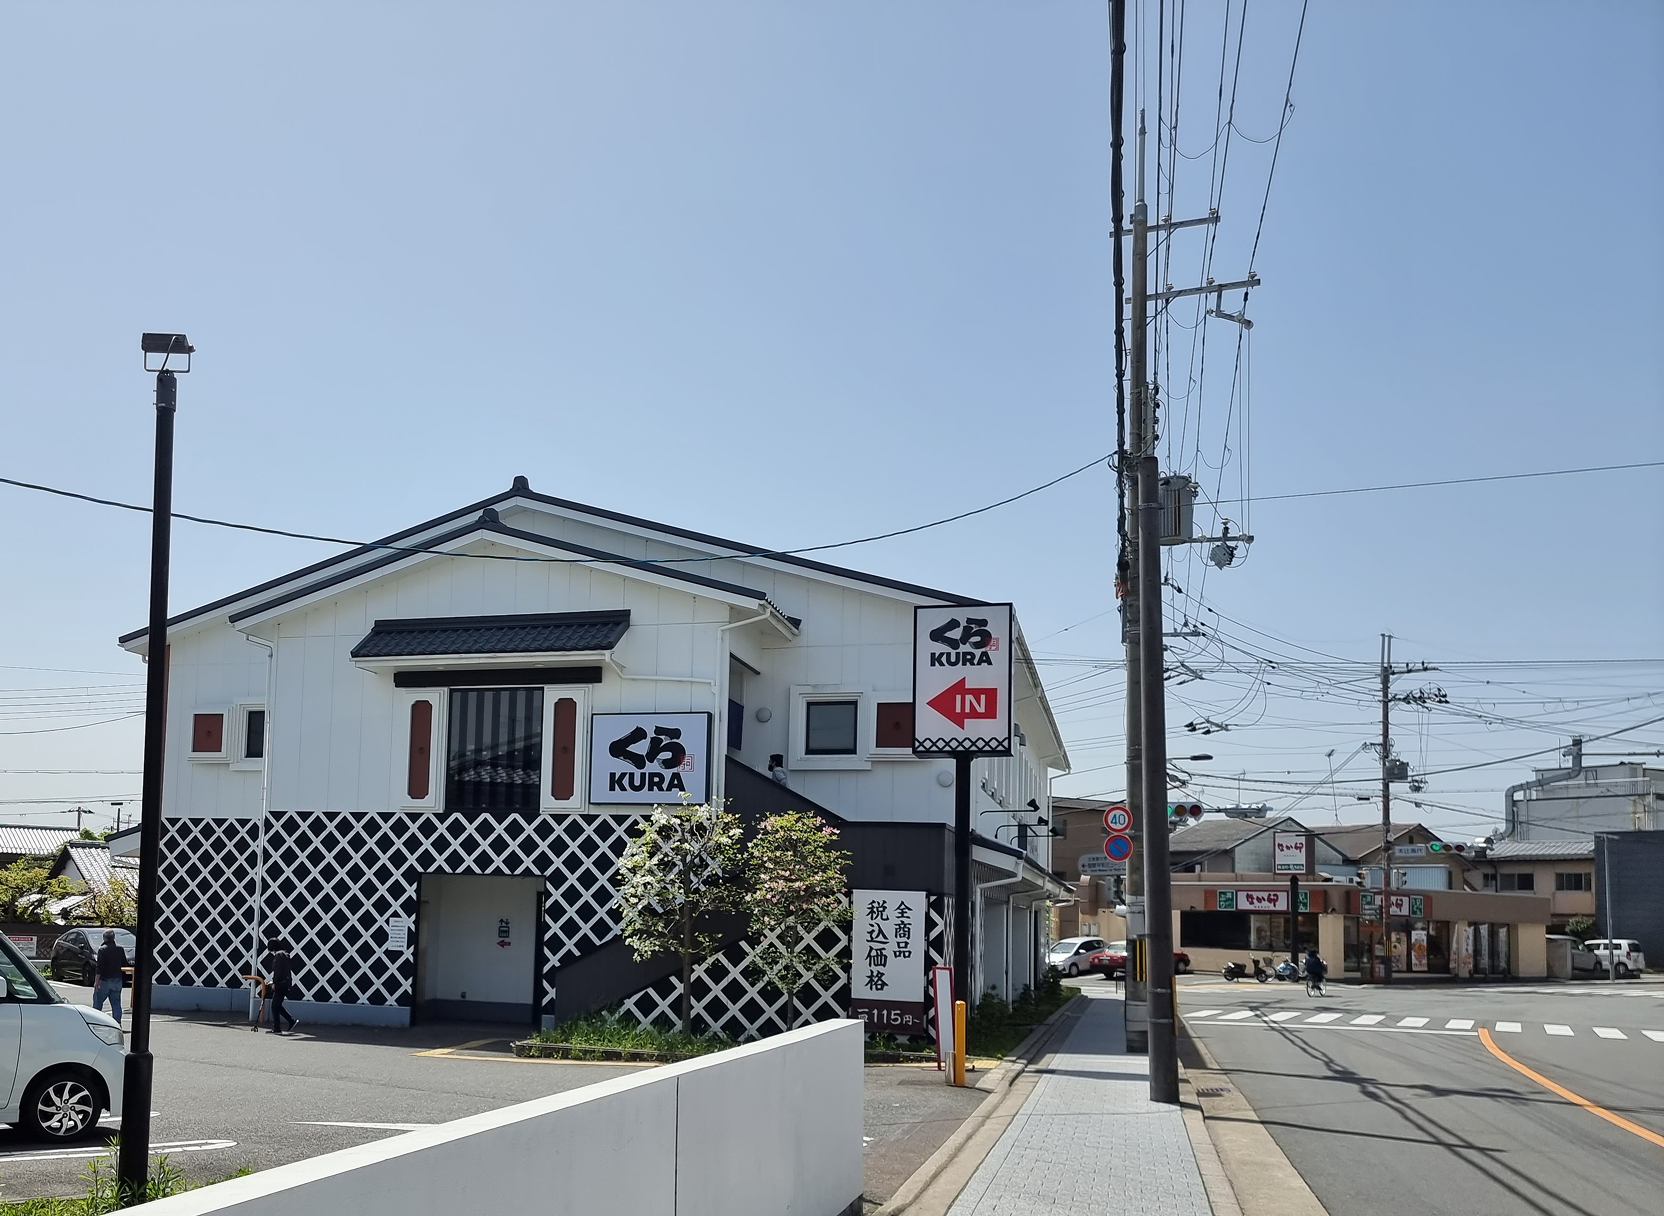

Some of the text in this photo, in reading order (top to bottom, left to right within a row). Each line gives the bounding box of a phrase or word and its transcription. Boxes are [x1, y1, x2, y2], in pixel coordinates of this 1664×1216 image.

[929, 617, 993, 651] くら
[929, 651, 993, 667] KURA
[955, 694, 986, 713] IN
[608, 725, 686, 770] くら
[608, 772, 686, 792] KURA
[1110, 813, 1126, 826] 40
[892, 900, 913, 959] 全商品
[864, 899, 890, 992] 税込価格
